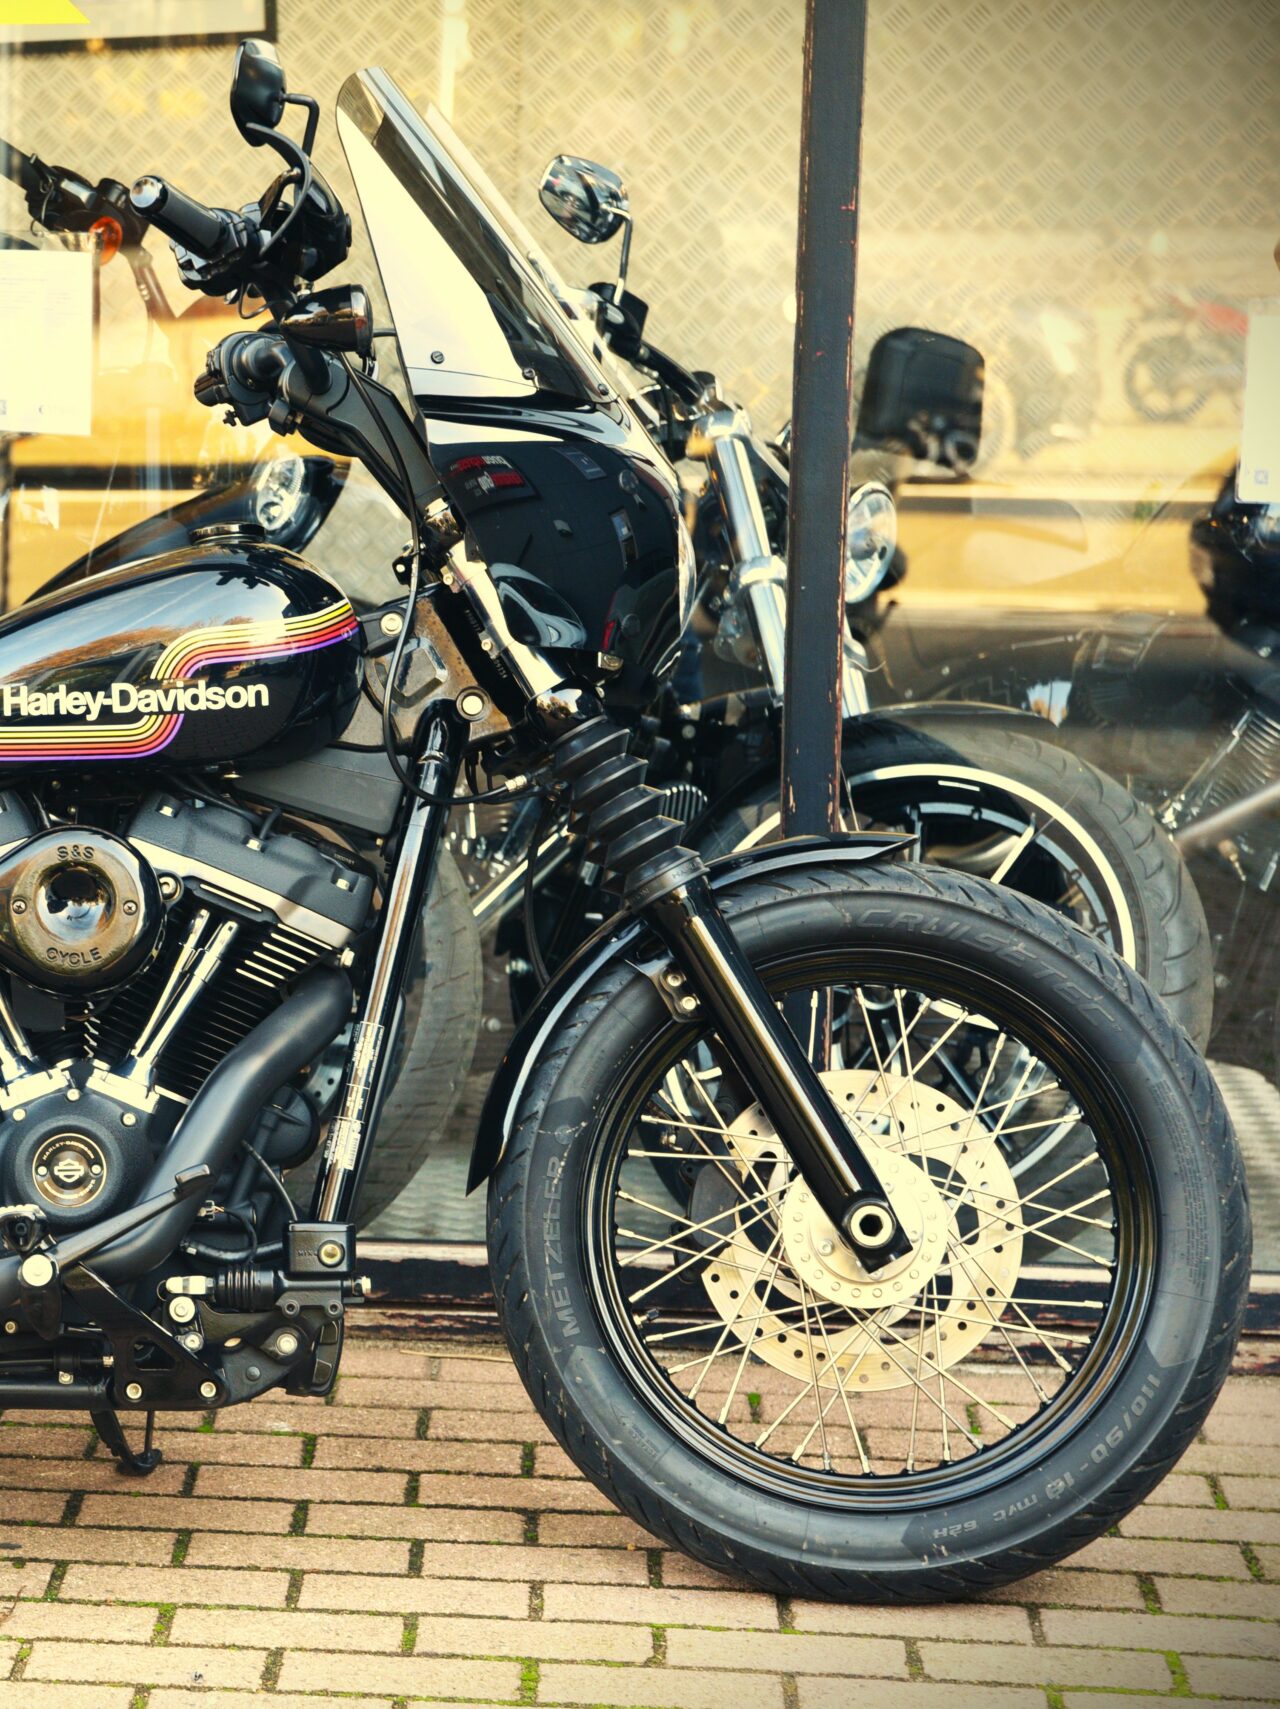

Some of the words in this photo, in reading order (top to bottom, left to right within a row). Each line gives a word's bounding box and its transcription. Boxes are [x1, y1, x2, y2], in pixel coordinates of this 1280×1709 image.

[2, 679, 270, 722] Harley-Davidson
[56, 844, 96, 861] S&S
[45, 946, 103, 968] CYCLE
[543, 1155, 582, 1339] METZELER
